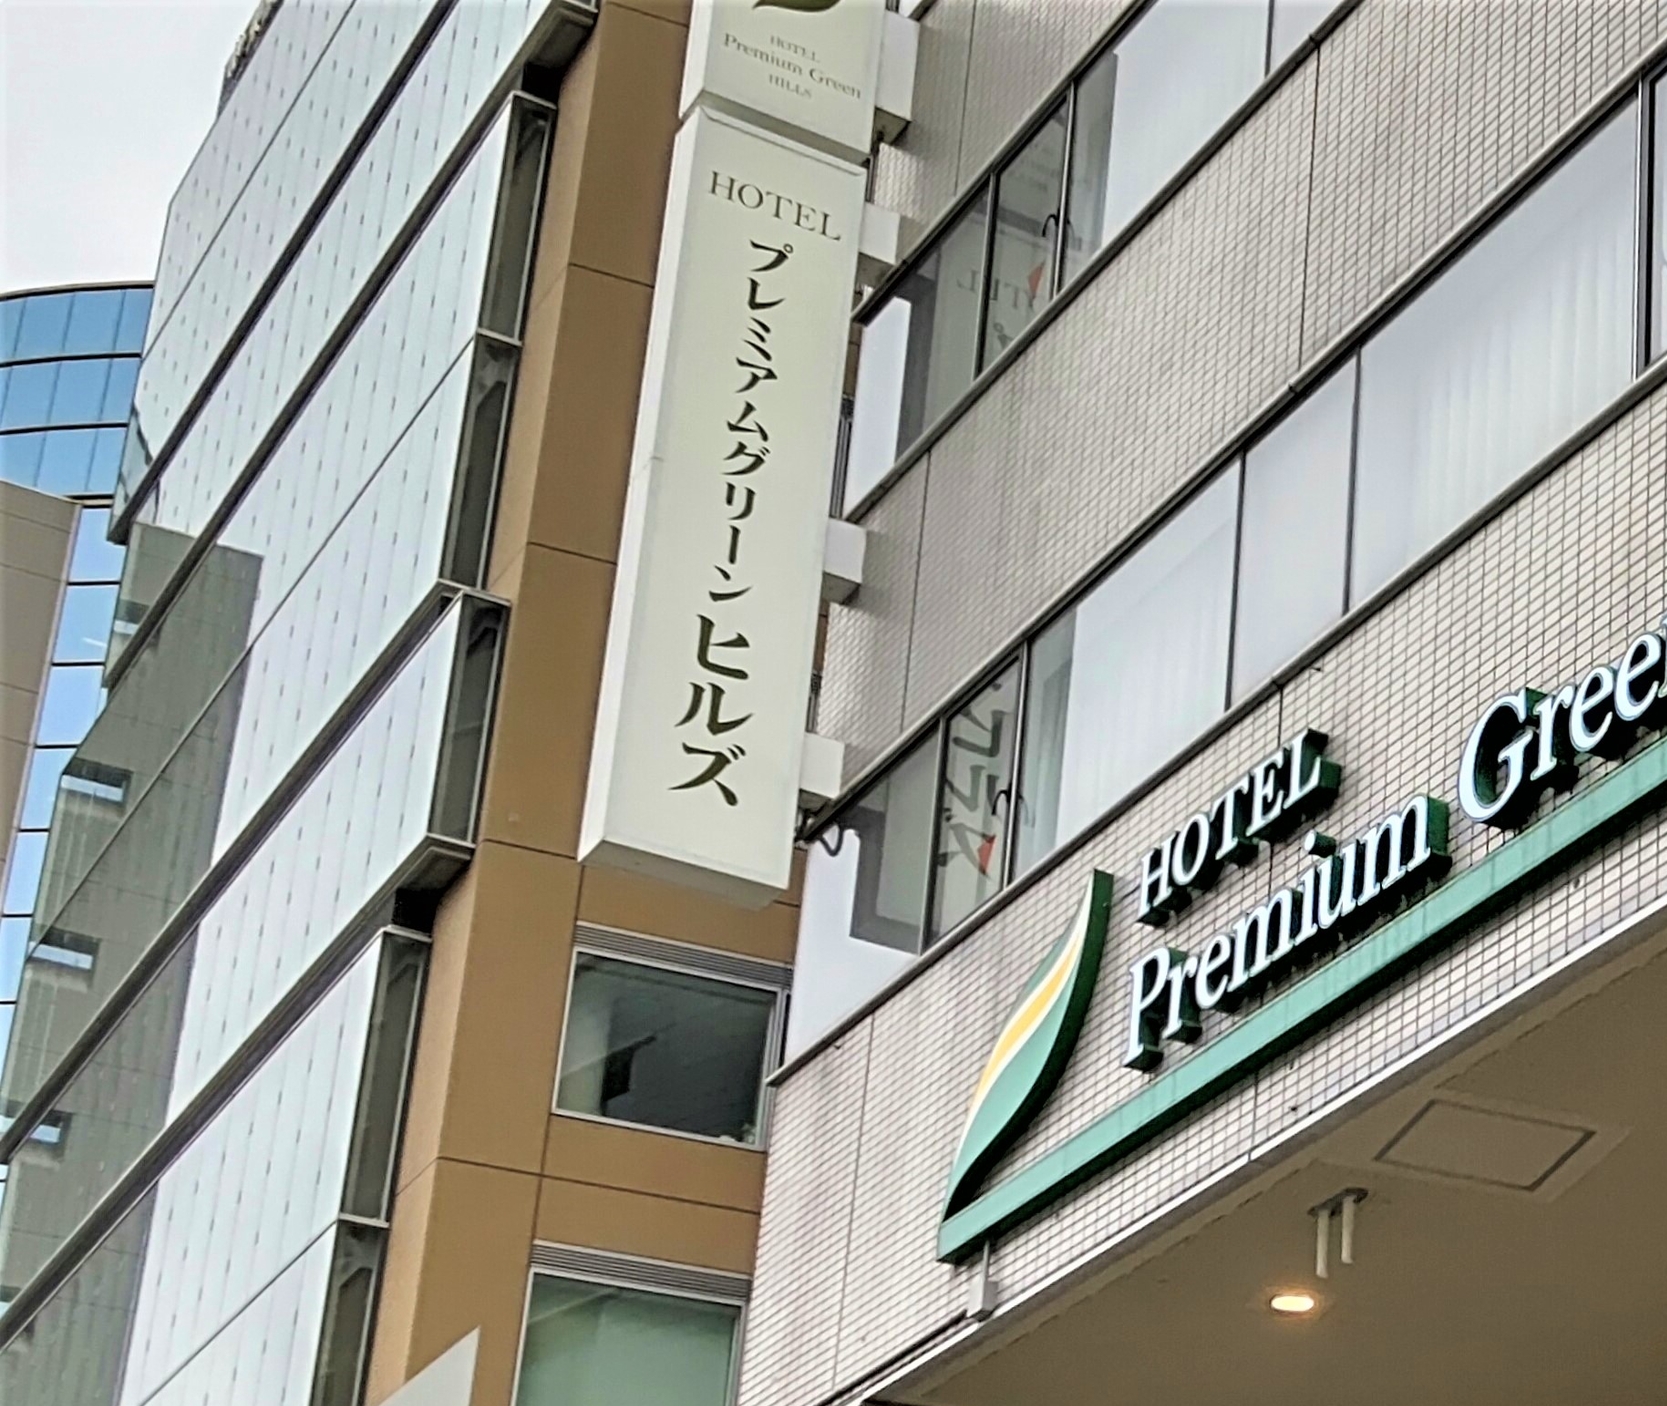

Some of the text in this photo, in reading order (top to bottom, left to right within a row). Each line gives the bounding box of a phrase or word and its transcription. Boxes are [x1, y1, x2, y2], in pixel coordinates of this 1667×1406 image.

[723, 33, 862, 99] Premium Green
[770, 34, 821, 63] HOTEL
[768, 73, 813, 99] HILLS
[708, 170, 842, 242] HOTEL
[667, 239, 795, 807] プレミアムグリーンヒルズ
[1137, 729, 1330, 920] HOTEL
[1124, 791, 1438, 1069] Premium
